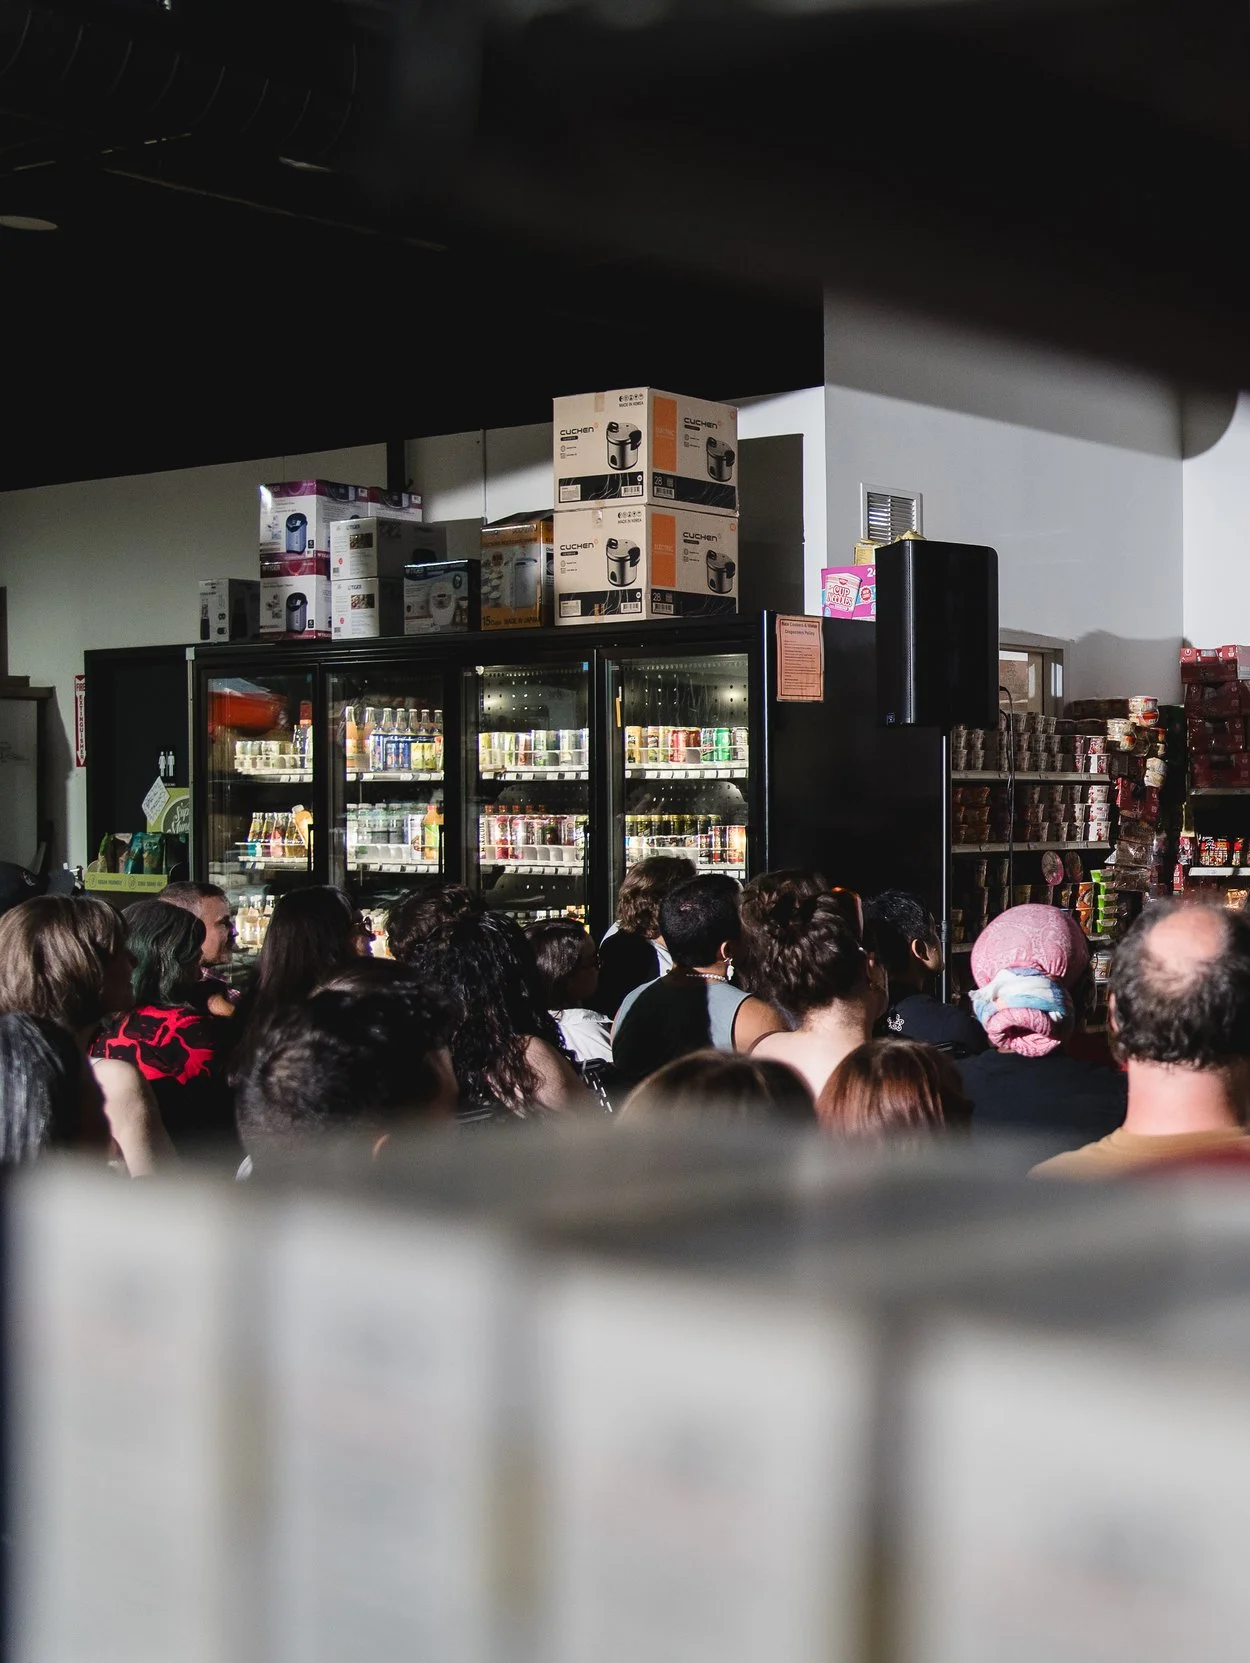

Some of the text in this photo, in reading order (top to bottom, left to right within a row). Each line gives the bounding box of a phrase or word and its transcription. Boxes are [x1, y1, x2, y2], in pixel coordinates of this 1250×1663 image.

[683, 417, 718, 430] CUCHEN
[560, 426, 595, 436] CUCHEN
[682, 531, 718, 542] CUCHEN
[560, 542, 595, 551] CUCHEN
[833, 584, 851, 597] CUP
[827, 591, 853, 607] NOODLES
